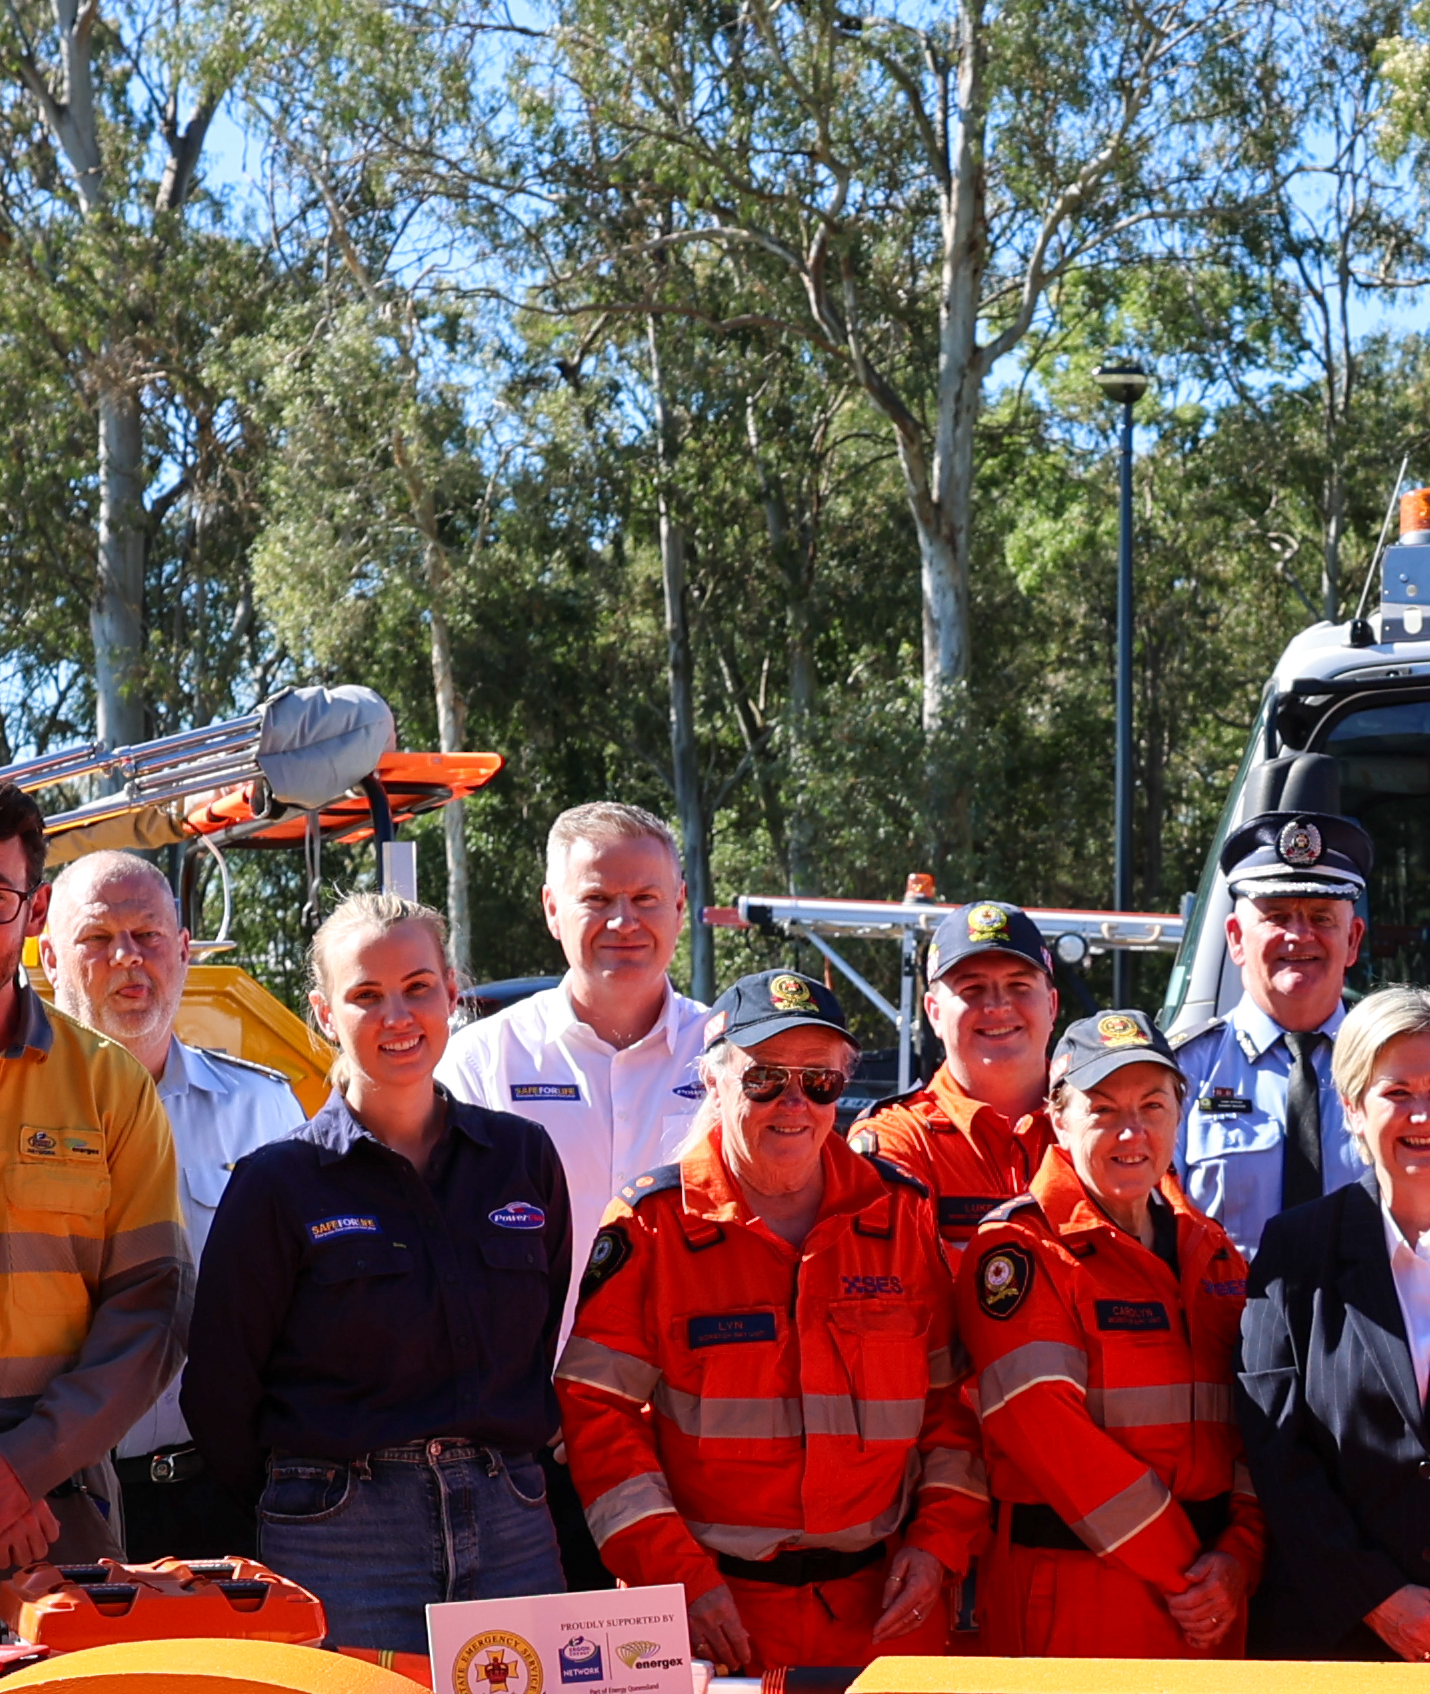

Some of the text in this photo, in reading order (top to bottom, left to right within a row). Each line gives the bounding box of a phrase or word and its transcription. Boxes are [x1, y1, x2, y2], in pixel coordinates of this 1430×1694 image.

[862, 1276, 904, 1294] SES
[560, 1614, 676, 1631] PROUDLY SUPPORTED BY
[635, 1657, 683, 1671] energex
[563, 1667, 600, 1677] NETWORK
